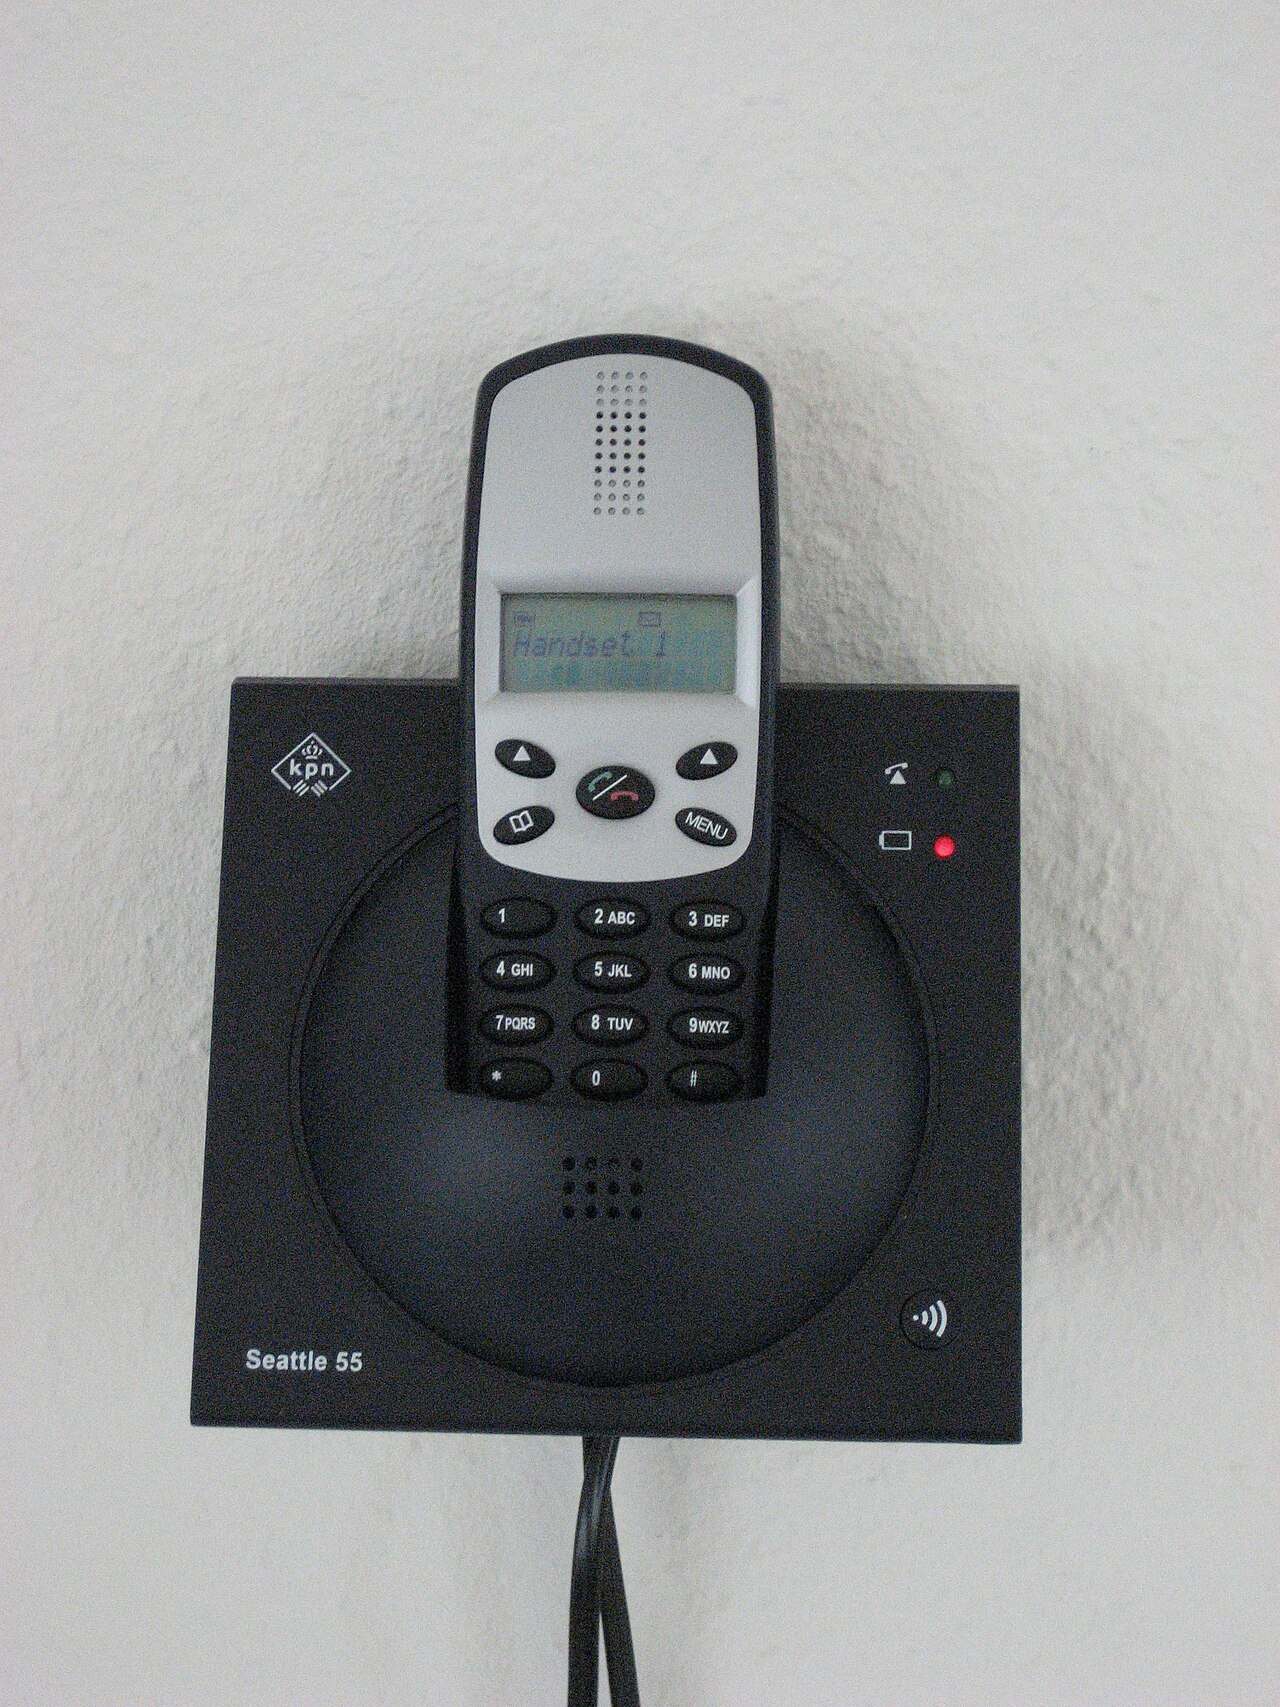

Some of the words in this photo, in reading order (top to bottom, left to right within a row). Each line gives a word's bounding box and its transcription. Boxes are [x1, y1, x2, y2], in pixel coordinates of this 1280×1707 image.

[289, 758, 334, 780] kpn
[685, 811, 728, 840] MENU
[498, 908, 506, 923] 1
[594, 908, 604, 925] 2
[607, 911, 636, 926] ABC
[688, 911, 698, 927] 3
[704, 914, 730, 928] DEF
[496, 961, 505, 977] 4
[511, 963, 534, 977] GHI
[594, 961, 603, 977] 5
[608, 964, 633, 978] JKL
[688, 963, 698, 979] 6
[701, 966, 731, 980] MNO
[591, 1015, 600, 1031] 8
[607, 1017, 634, 1031] TUV
[245, 1349, 328, 1372] Seattle
[335, 1351, 363, 1373] 55
